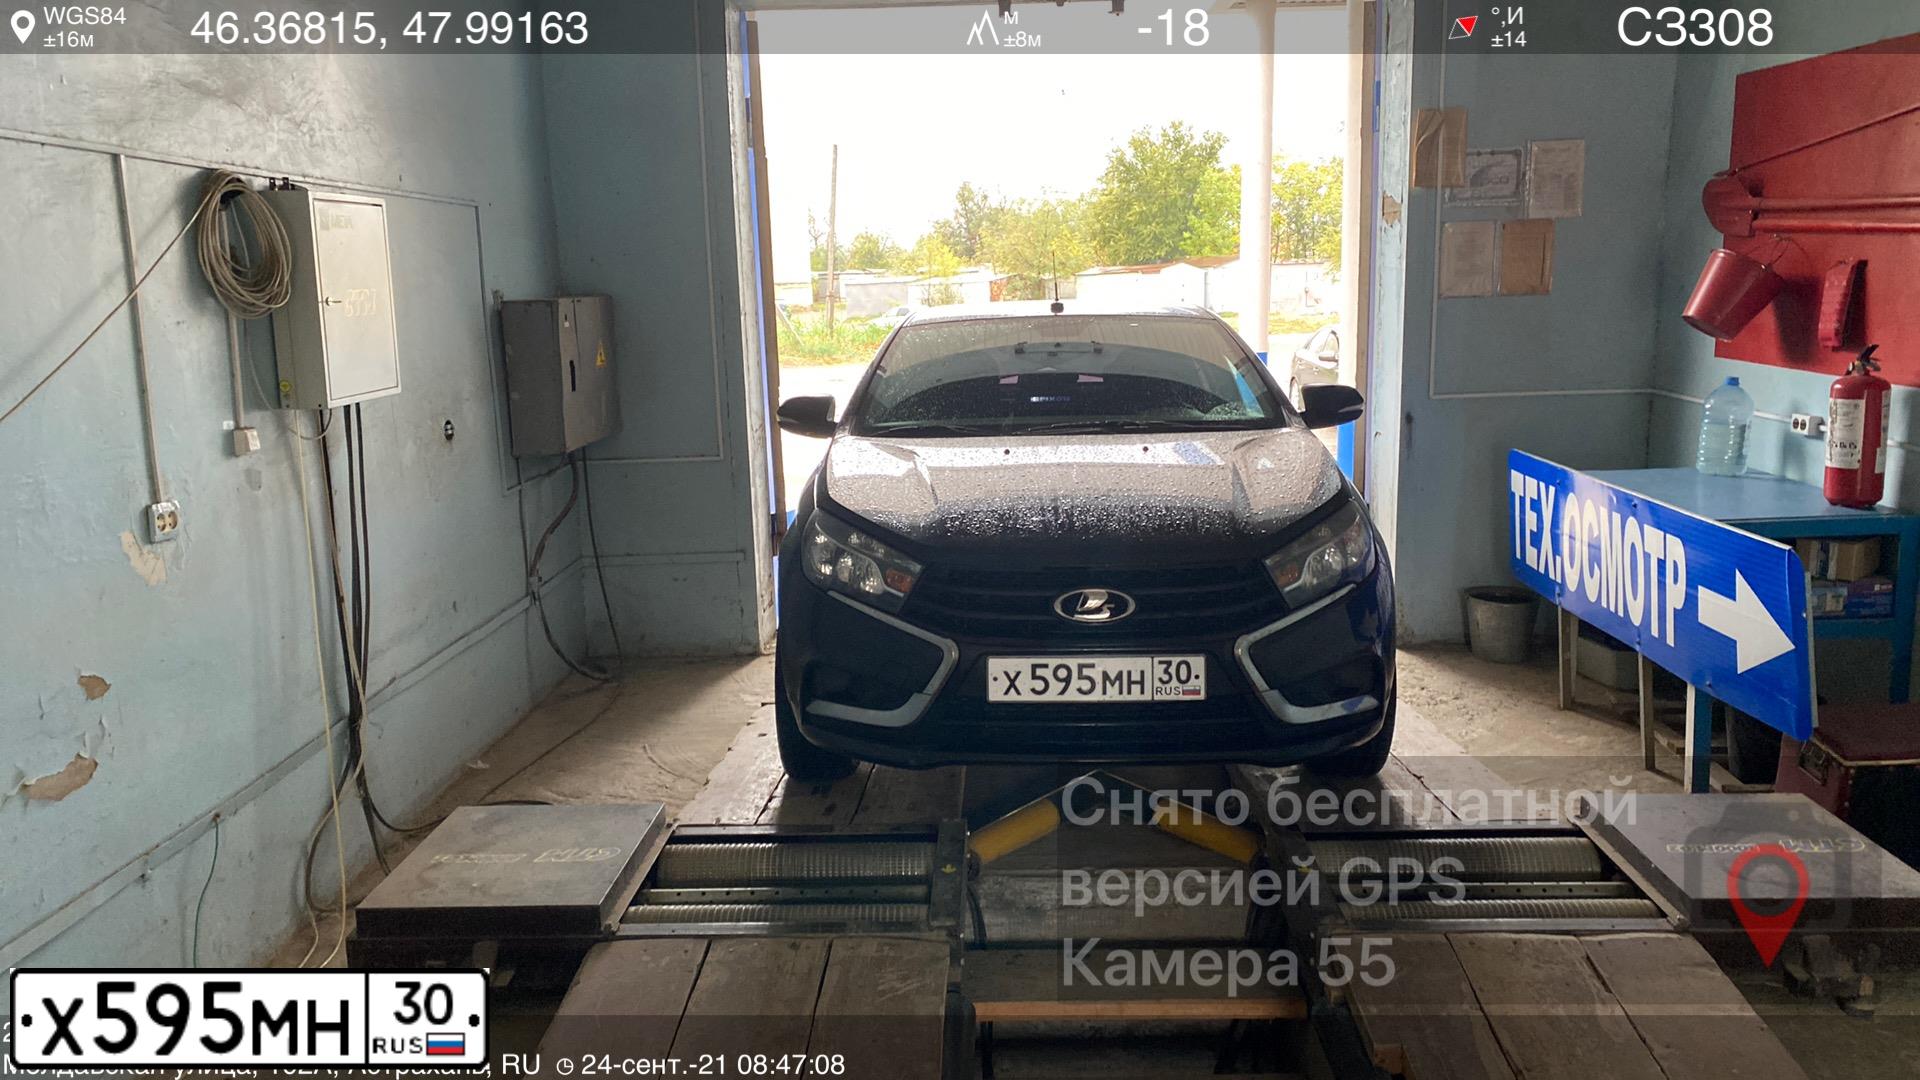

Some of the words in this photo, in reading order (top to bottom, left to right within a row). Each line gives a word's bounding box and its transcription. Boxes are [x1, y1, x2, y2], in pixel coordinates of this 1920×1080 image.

[1510, 469, 1687, 648] ТЕХ.ОСМОТР
[1157, 659, 1193, 685] 30
[1155, 686, 1181, 696] RUS
